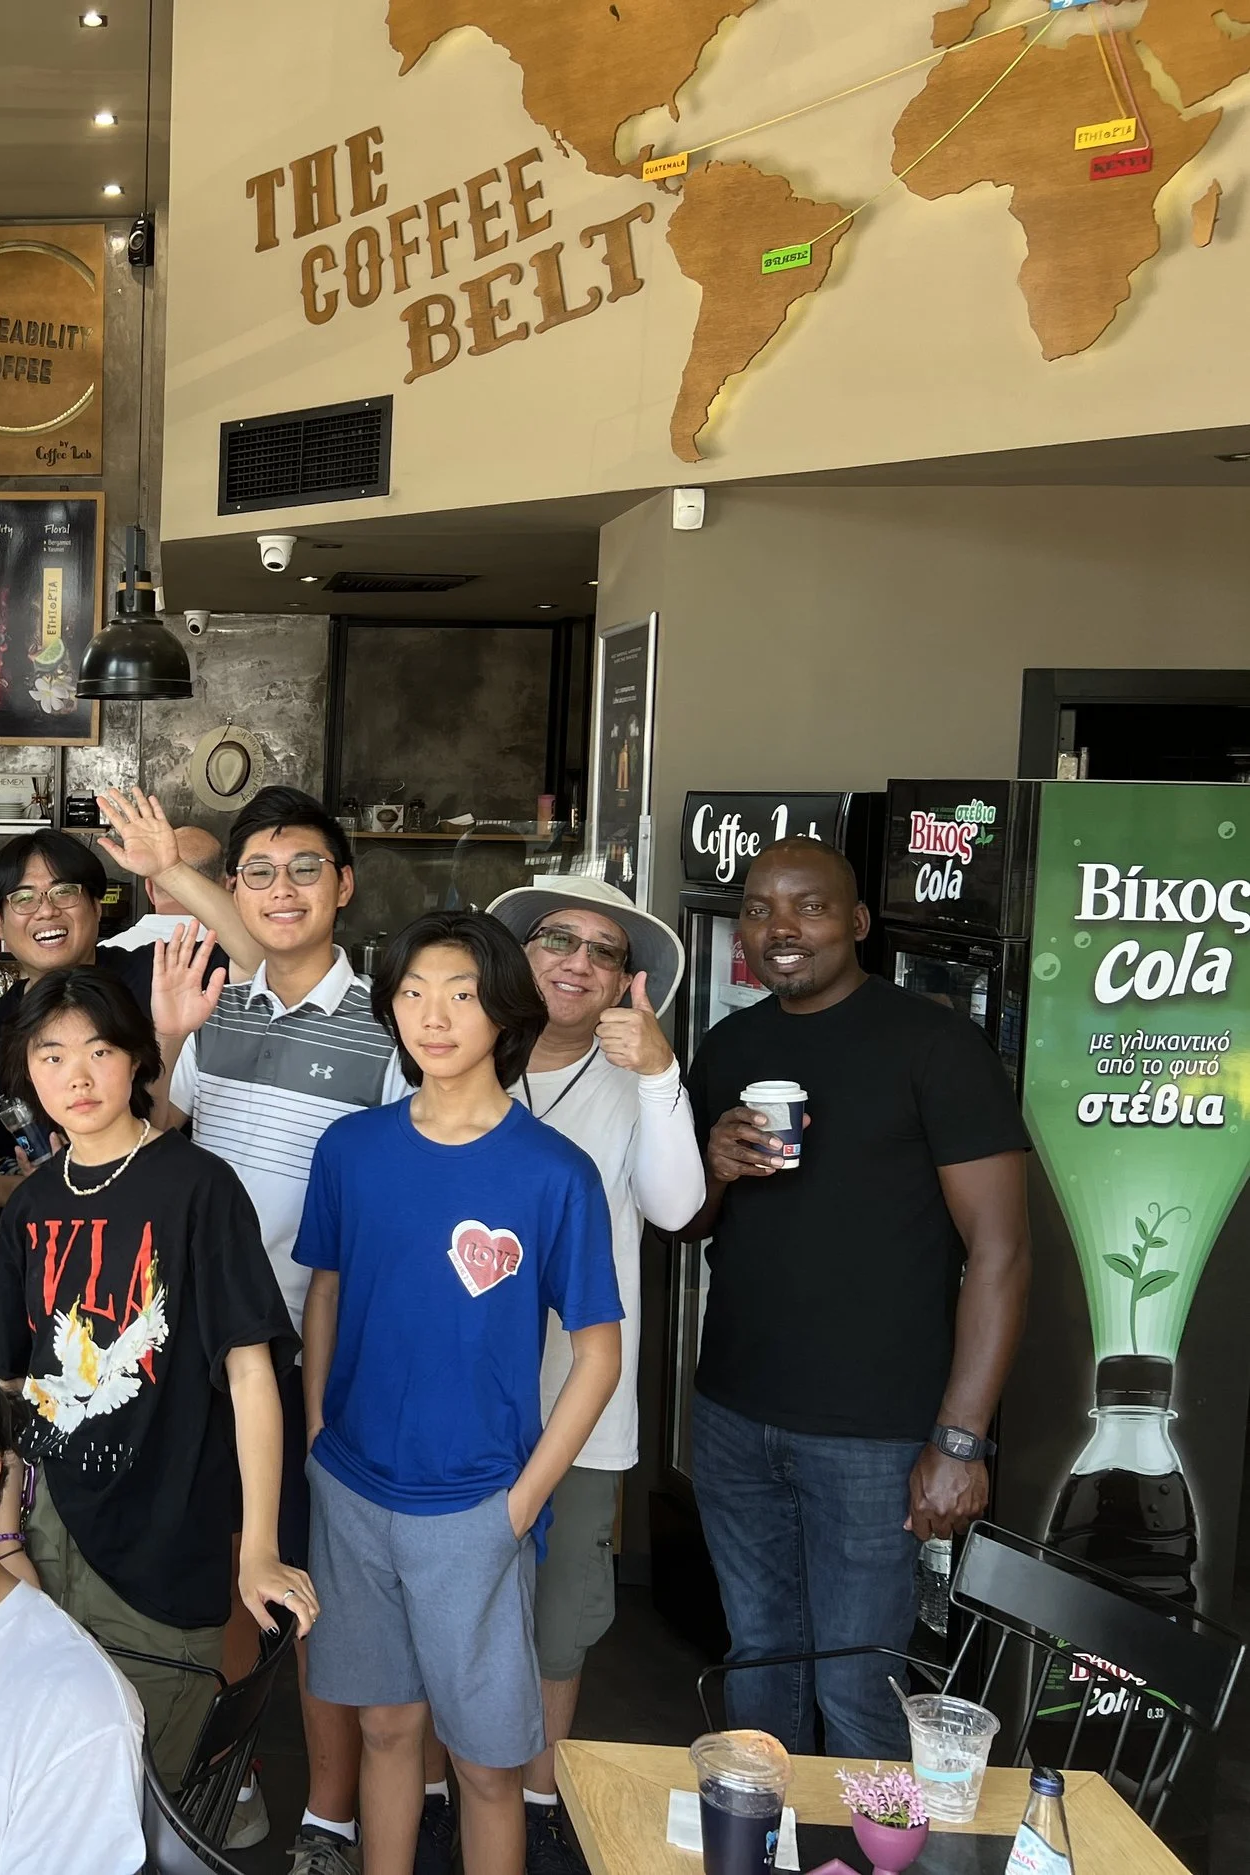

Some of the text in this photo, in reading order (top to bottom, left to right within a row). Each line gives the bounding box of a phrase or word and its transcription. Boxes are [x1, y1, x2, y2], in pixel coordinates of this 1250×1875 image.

[1078, 127, 1132, 143] ETHIOPIA
[246, 126, 388, 253] THE
[645, 160, 686, 175] GUATEMALA
[301, 147, 552, 325] COFFEE
[764, 250, 808, 268] BRASIL
[400, 202, 654, 384] BELT
[36, 446, 92, 466] Coffee Lab
[44, 523, 70, 534] Floral
[955, 799, 997, 825] στέβια
[692, 803, 823, 883] Coffee Lb
[908, 811, 973, 865] Βίκος
[914, 859, 963, 903] Cola
[1073, 862, 1250, 935] Βίκος
[1094, 931, 1233, 1005] Cola
[1089, 1029, 1231, 1055] με γλυκαντικό
[1097, 1053, 1221, 1079] από το φυτό
[1077, 1080, 1225, 1126] στέβια
